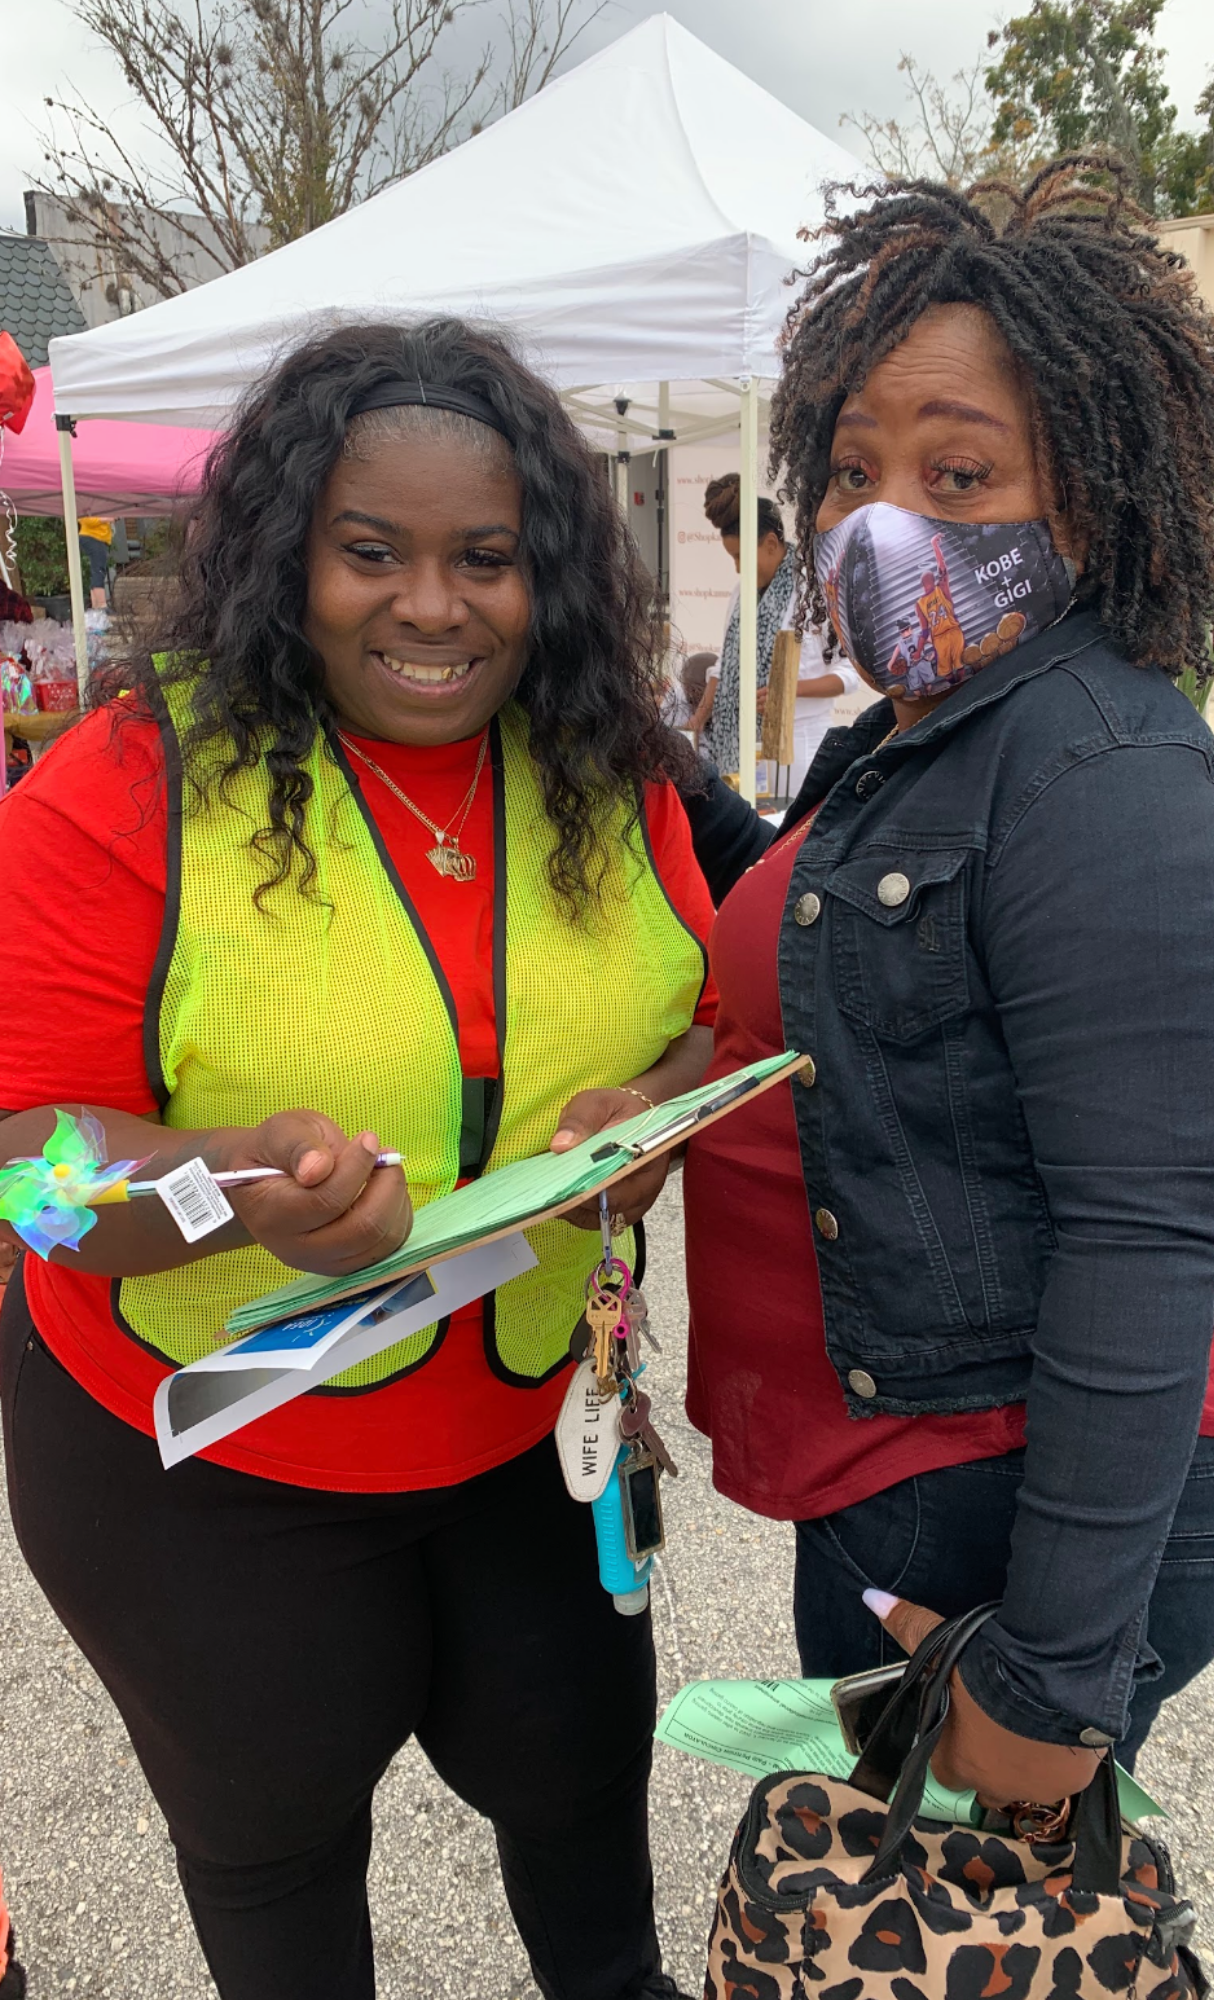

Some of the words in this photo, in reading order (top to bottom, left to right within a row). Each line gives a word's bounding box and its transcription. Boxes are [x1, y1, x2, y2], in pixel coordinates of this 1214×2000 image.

[974, 547, 1024, 585] KOBE
[993, 578, 1033, 608] GIGI
[928, 604, 948, 627] 24
[581, 1433, 599, 1478] WIFE
